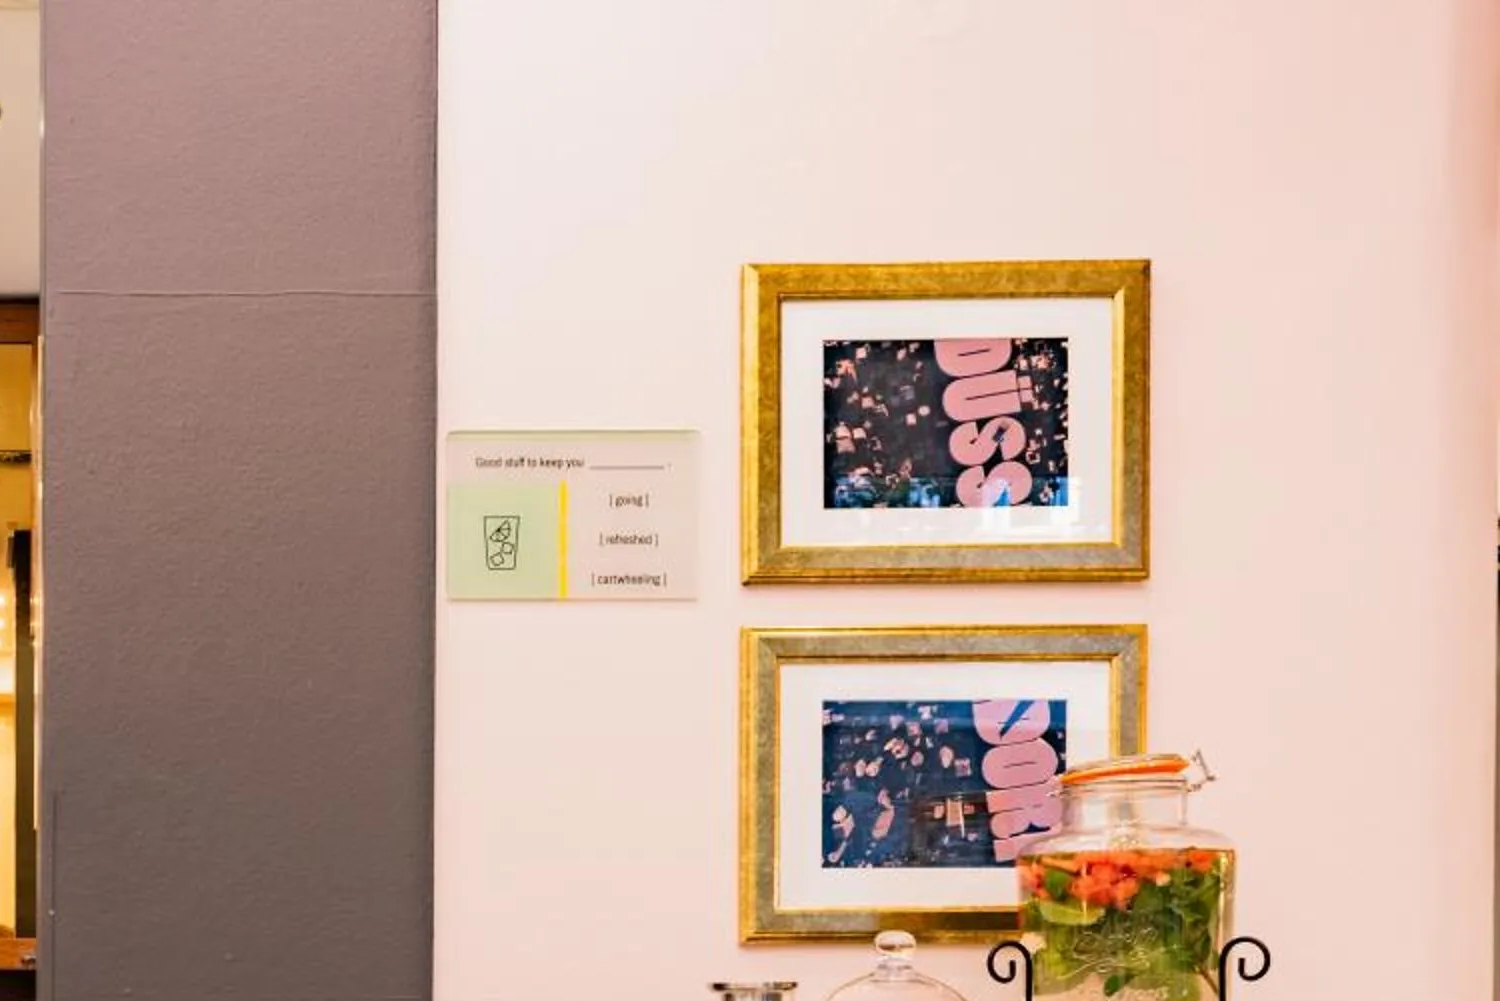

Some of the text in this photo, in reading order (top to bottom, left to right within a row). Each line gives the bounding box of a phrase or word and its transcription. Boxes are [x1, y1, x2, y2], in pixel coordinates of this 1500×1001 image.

[475, 456, 585, 471] Good stuff to keep you
